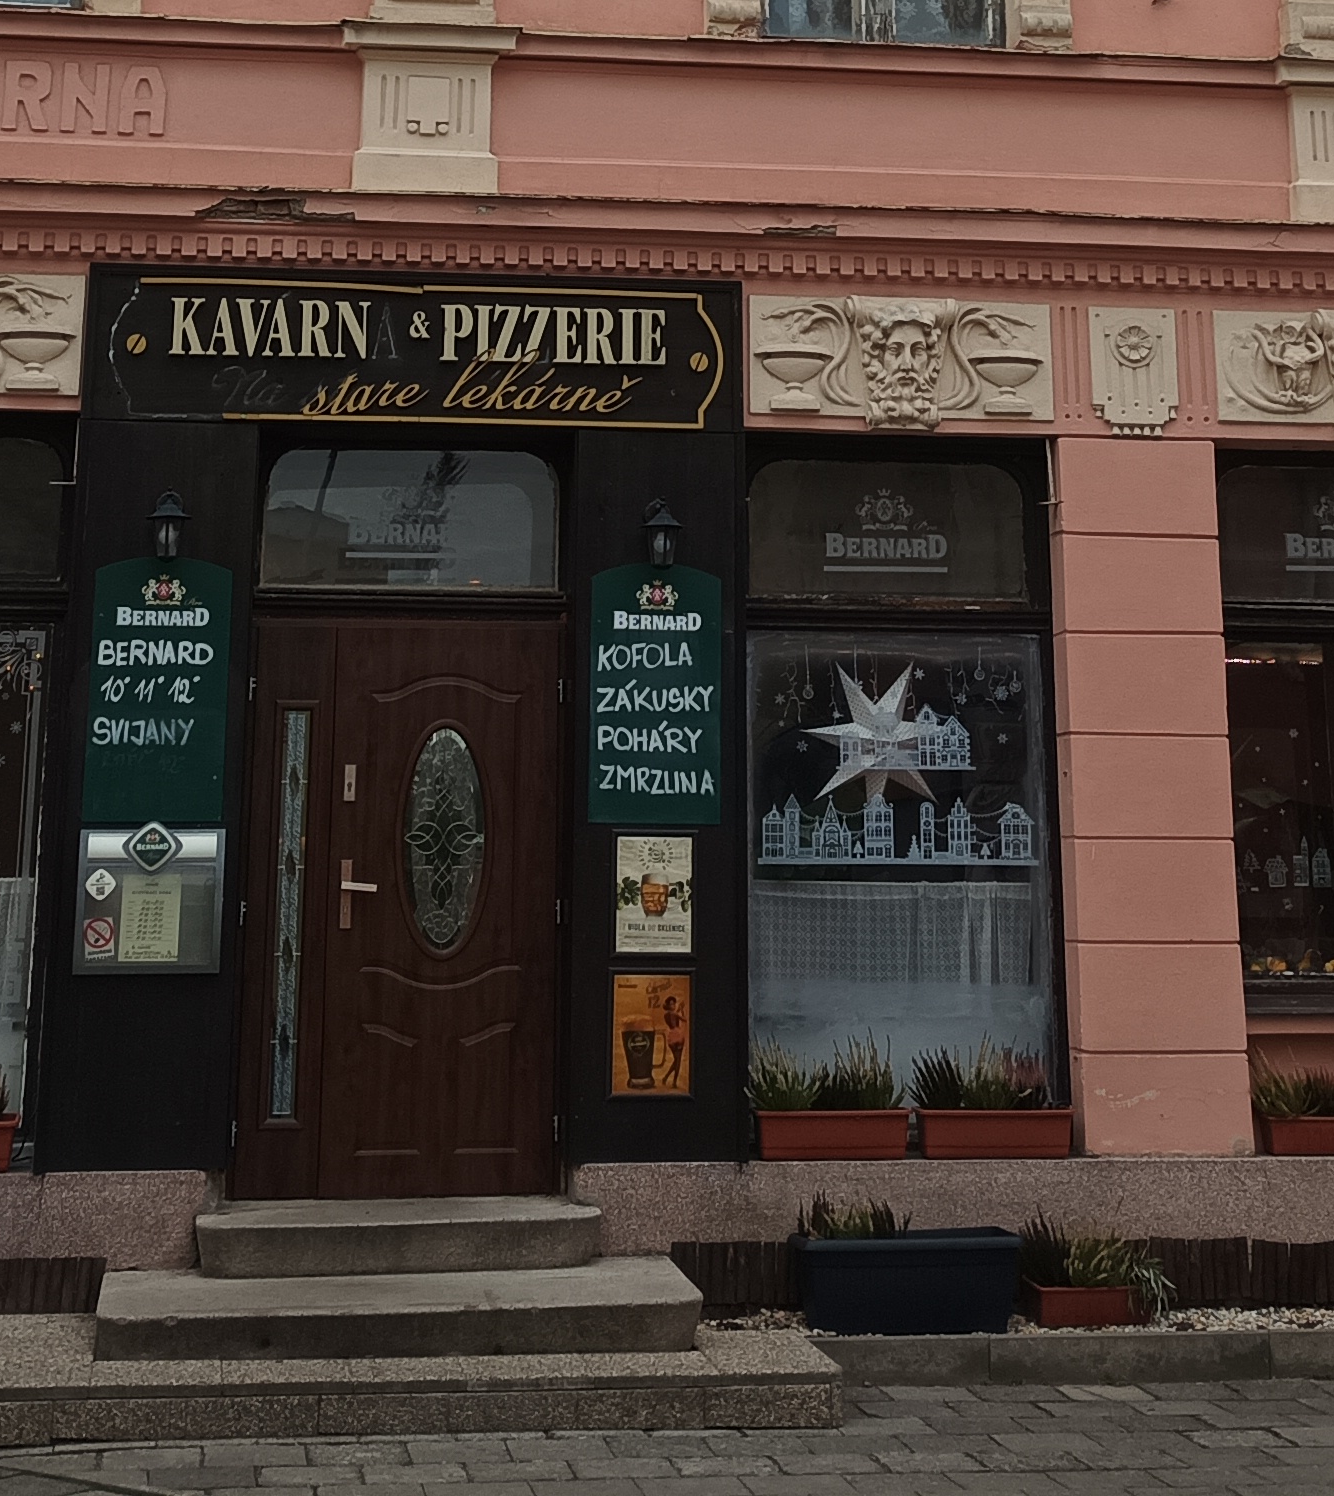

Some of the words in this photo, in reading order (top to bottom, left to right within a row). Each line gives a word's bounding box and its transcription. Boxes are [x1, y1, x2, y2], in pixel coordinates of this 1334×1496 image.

[409, 310, 430, 339] &
[439, 303, 666, 365] PIZZERIE
[824, 532, 948, 560] BERNARD
[116, 606, 210, 627] BERNARD
[614, 610, 702, 631] BERNARD
[97, 639, 214, 666] BERNARD
[597, 642, 693, 672] KOFOLA
[596, 679, 714, 713] ZÁKUSKY
[92, 716, 195, 746] SVIJANY
[597, 720, 703, 753] POHÁRY
[598, 764, 715, 796] ZMRZLINA
